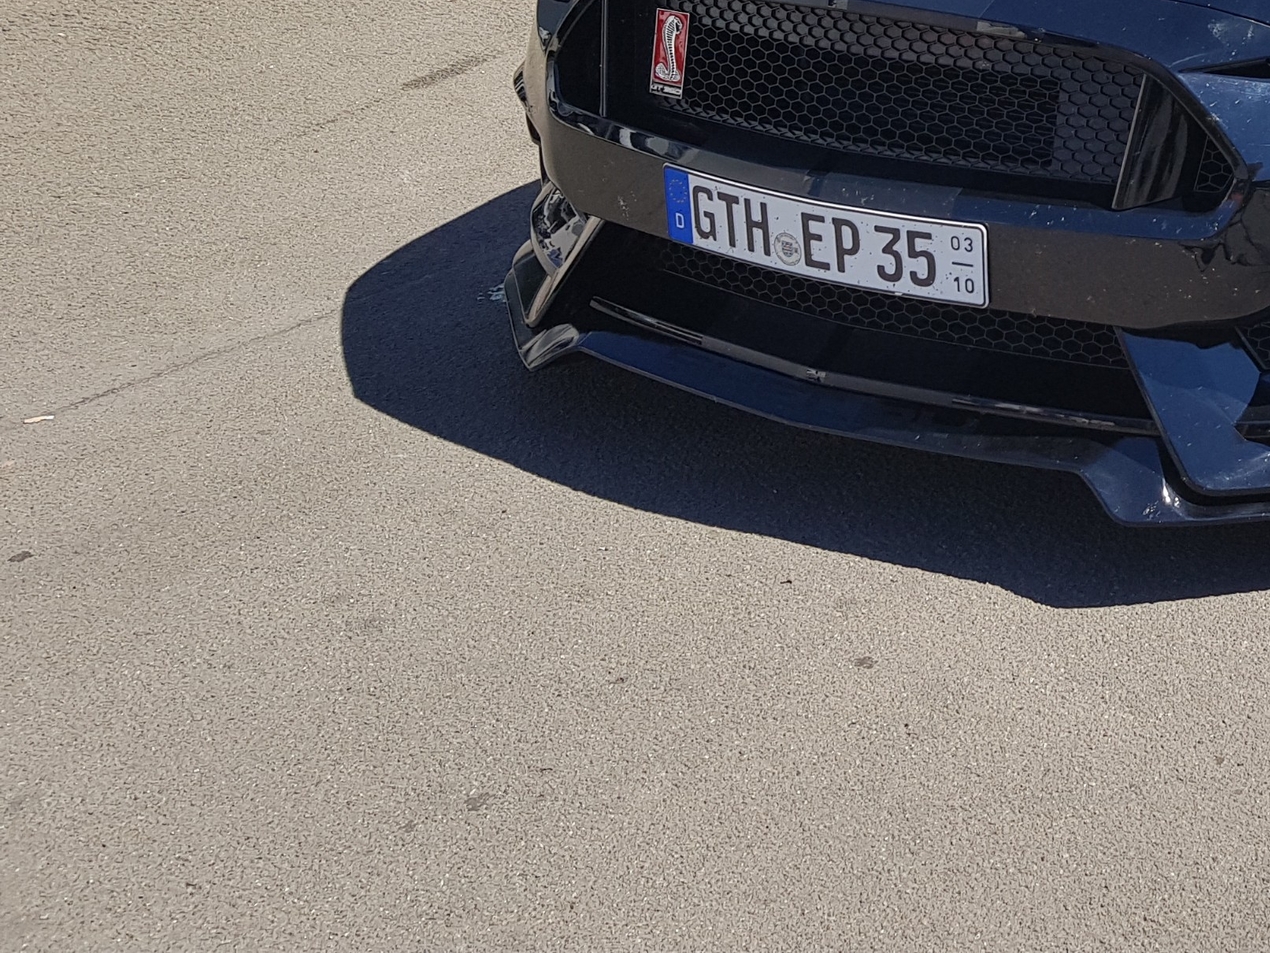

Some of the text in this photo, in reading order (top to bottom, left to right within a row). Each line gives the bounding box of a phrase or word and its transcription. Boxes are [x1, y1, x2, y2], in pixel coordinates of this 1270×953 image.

[675, 212, 685, 229] D
[692, 185, 772, 257] GTH
[801, 212, 861, 273] EP
[874, 225, 937, 287] 35
[950, 235, 974, 253] 03
[953, 275, 975, 294] 10
